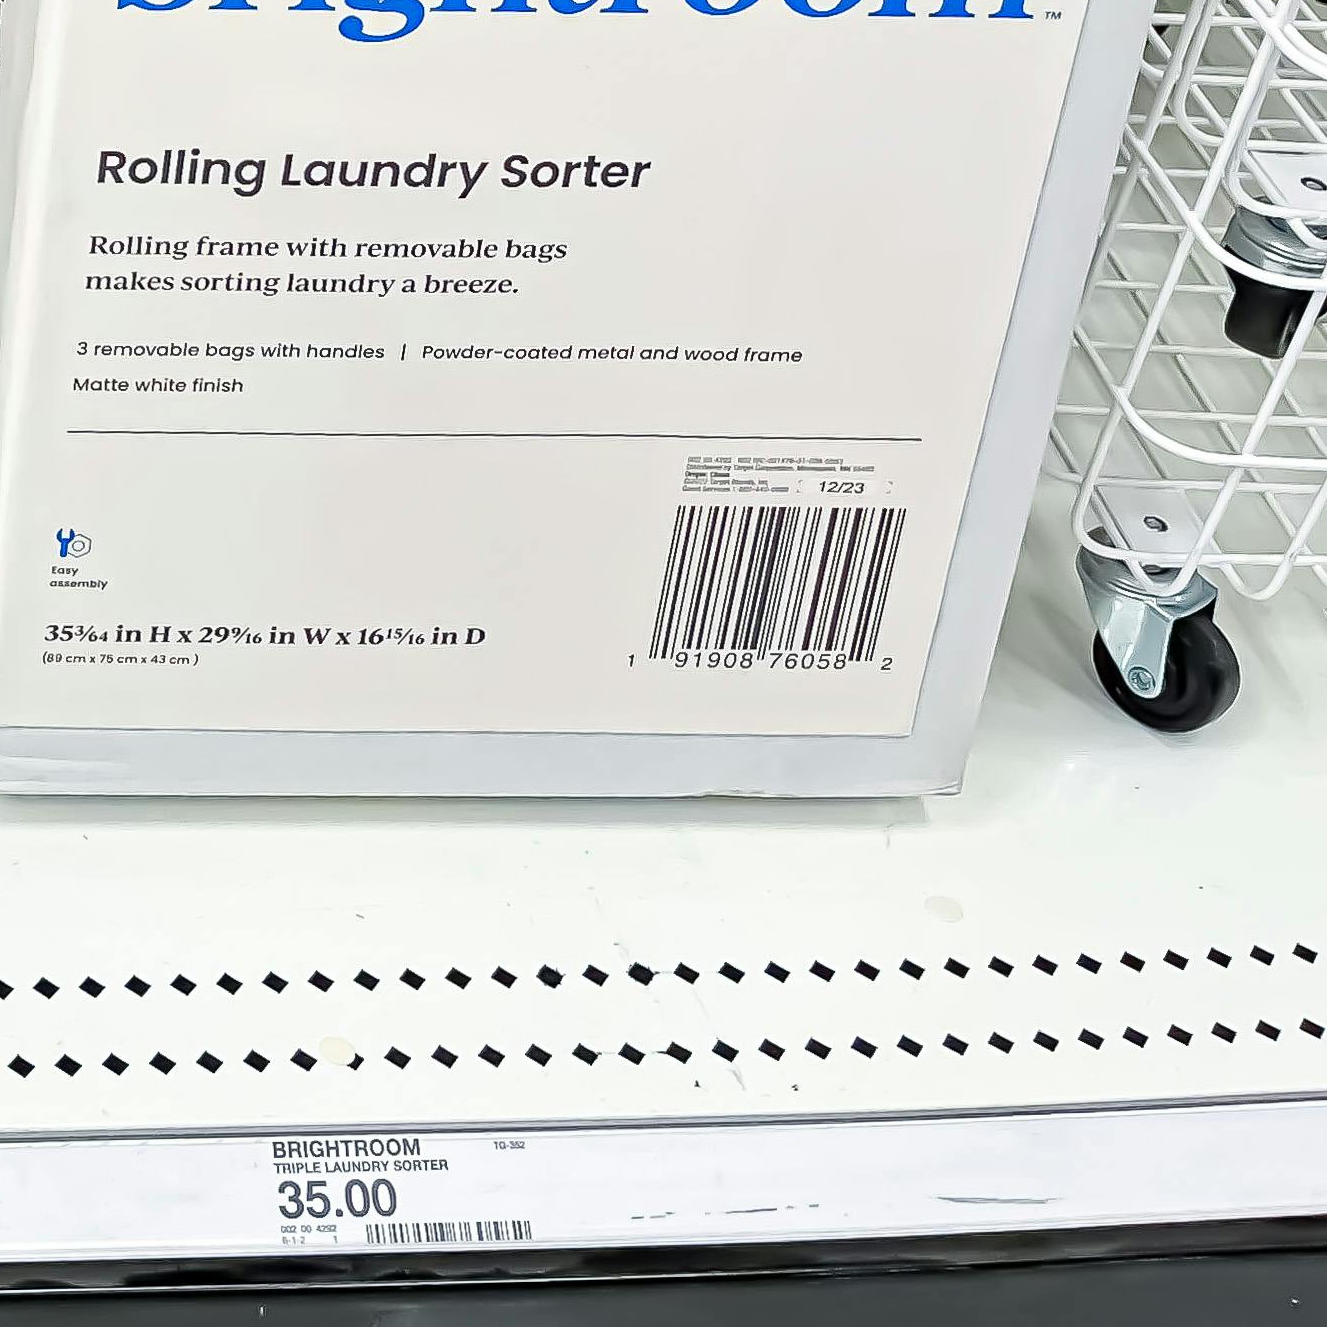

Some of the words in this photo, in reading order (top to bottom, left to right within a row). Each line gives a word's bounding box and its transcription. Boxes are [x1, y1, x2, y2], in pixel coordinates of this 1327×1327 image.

[97, 149, 267, 197] Rolling
[281, 152, 490, 197] Laundry
[500, 154, 652, 188] Sorter
[89, 235, 189, 261] Rolling
[195, 235, 279, 257] frame
[285, 237, 348, 258] with
[354, 238, 498, 259] removable
[505, 239, 567, 264] bags
[85, 271, 175, 291] makes
[180, 272, 281, 297] sorting
[286, 273, 396, 298] laundry
[401, 278, 417, 293] a
[423, 274, 519, 294] breeze.
[94, 342, 200, 357] removable
[205, 342, 256, 362] bags
[260, 342, 301, 360] with
[306, 344, 385, 362] handles
[420, 345, 573, 362] Powder-coated
[577, 345, 635, 360] metal
[639, 345, 680, 360] and
[684, 347, 739, 362] wood
[743, 347, 803, 363] frame
[73, 378, 129, 392] Matte
[135, 377, 187, 393] white
[192, 377, 243, 393] finish
[819, 480, 865, 495] 12/23
[51, 566, 79, 577] Easy
[49, 579, 108, 591] assembly
[674, 652, 754, 670] 91908
[769, 653, 847, 670] 76058
[272, 1138, 421, 1159] BRIGHTROOM
[273, 1161, 322, 1174] TRIPLE
[325, 1160, 389, 1173] LAUNDRY
[393, 1159, 449, 1172] SORTER
[277, 1178, 397, 1219] 35.00
